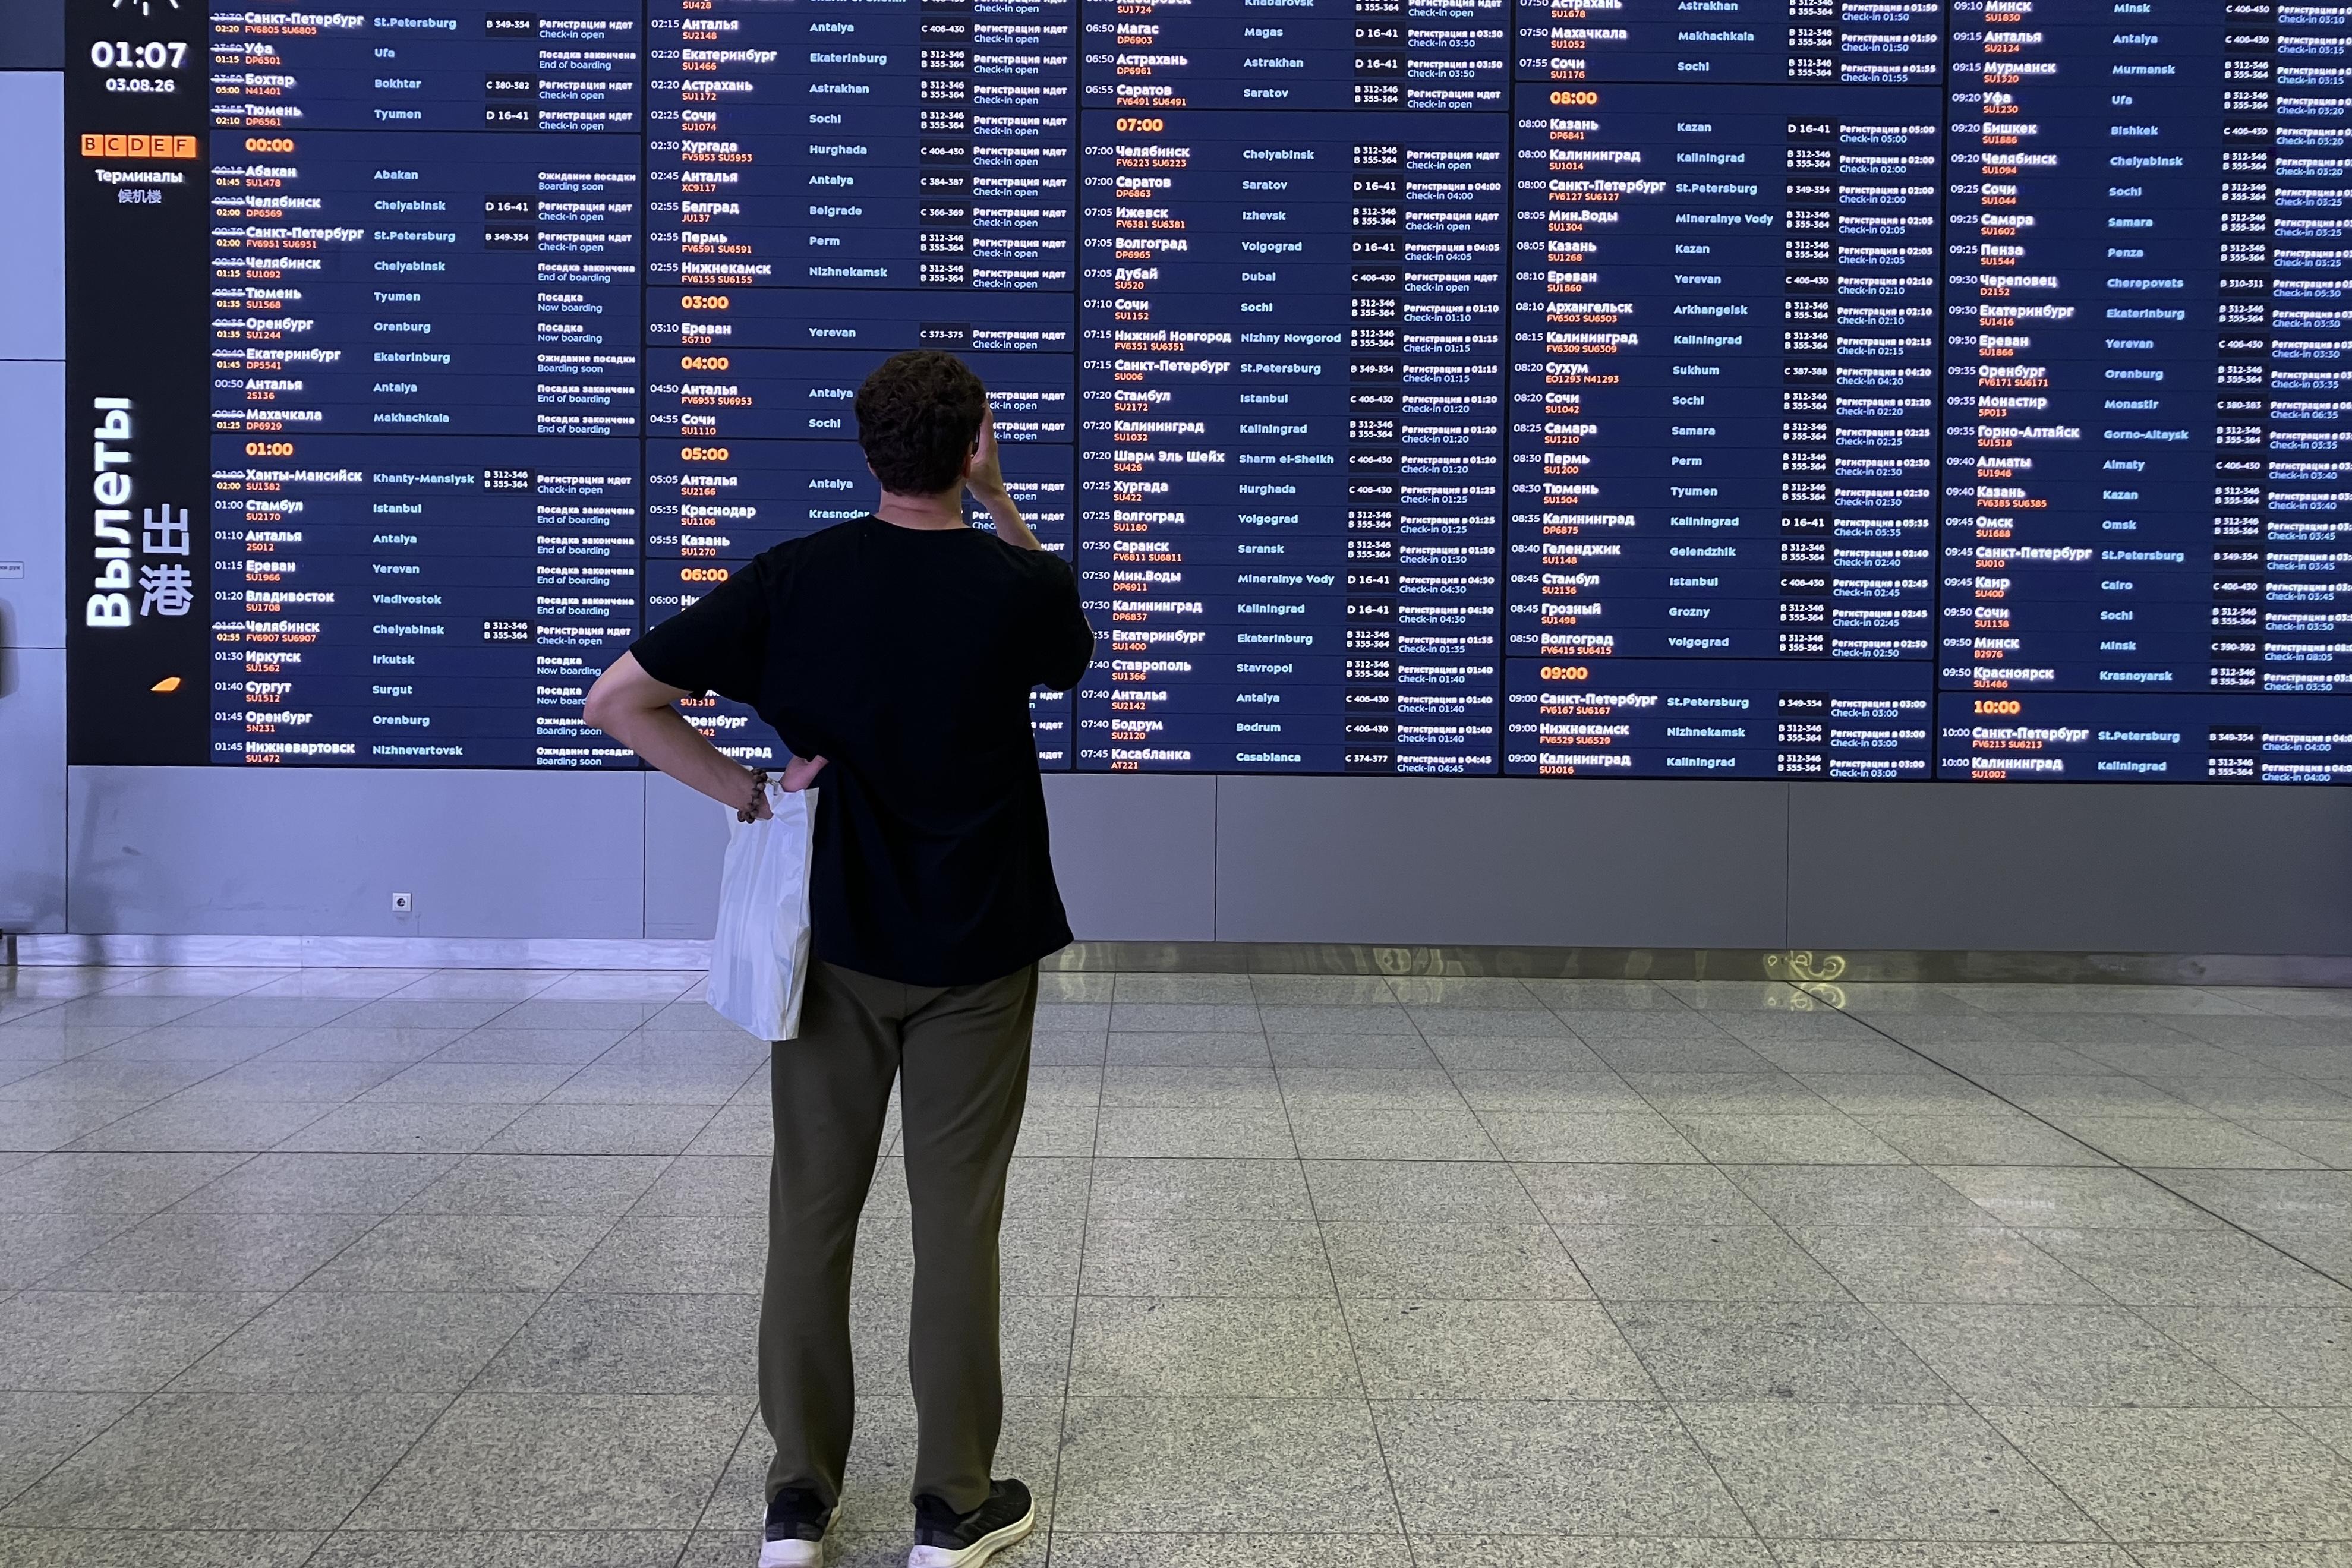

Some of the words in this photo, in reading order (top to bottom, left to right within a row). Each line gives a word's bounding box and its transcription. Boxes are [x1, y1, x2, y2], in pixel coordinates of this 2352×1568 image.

[245, 12, 365, 27] Санкт-Петербург
[374, 18, 456, 30] St.Petersburg
[540, 20, 606, 30] Регистрация
[609, 21, 633, 30] идет
[682, 19, 739, 30] Анталья
[540, 30, 578, 38] Check-in
[1117, 23, 1159, 34] Магас
[1244, 28, 1283, 39] Magas
[91, 41, 187, 68] 01:07
[244, 43, 274, 55] Уфа
[375, 48, 395, 57] Ufa
[540, 51, 581, 59] Посадка
[540, 61, 556, 69] End
[570, 61, 611, 71] boarding
[1984, 62, 2056, 74] Мурманск
[2113, 65, 2175, 74] Murmansk
[106, 78, 175, 92] 03.08.26
[244, 74, 294, 89] Бохтар
[375, 79, 421, 88] Bokhtar
[682, 80, 753, 93] Астрахань
[1550, 92, 1597, 104] 08:00
[374, 109, 421, 121] Tyumen
[487, 111, 494, 119] D
[499, 111, 528, 120] 16-41
[1117, 118, 1163, 131] 07:00
[1678, 123, 1711, 131] Kazan
[1982, 122, 2038, 135] Бишкек
[85, 138, 95, 150] B
[108, 138, 118, 151] C
[131, 139, 143, 151] D
[155, 139, 164, 152] E
[177, 140, 185, 152] F
[246, 138, 294, 152] 00:00
[681, 140, 738, 153] Хургада
[810, 145, 867, 156] Hurghada
[95, 169, 182, 184] Терминалы
[245, 165, 297, 178] Абакан
[374, 170, 418, 179] Abakan
[538, 172, 591, 181] Ожидание
[594, 173, 636, 182] посадки
[539, 182, 579, 192] Boarding
[118, 189, 161, 203] 候机楼
[682, 201, 739, 214] Белград
[810, 206, 862, 217] Belgrade
[1116, 207, 1168, 218] Ижевск
[1243, 211, 1285, 220] Izhevsk
[1116, 238, 1187, 251] Волгоград
[682, 262, 771, 275] Нижнекамск
[1980, 275, 2058, 288] Череповец
[2107, 279, 2183, 289] Cherepovets
[562, 304, 602, 313] boarding
[682, 296, 729, 309] 03:00
[1516, 302, 1544, 311] 08:10
[1546, 302, 1633, 314] Архангельск
[650, 324, 679, 332] 03:10
[682, 323, 732, 336] Ереван
[809, 328, 856, 337] Yerevan
[1115, 330, 1166, 341] Нижний
[1170, 331, 1231, 343] Новгород
[1241, 333, 1280, 344] Nizhny
[1284, 333, 1341, 345] Novgorod
[247, 348, 341, 362] Екатеринбург
[1546, 362, 1588, 375] Сухум
[1673, 365, 1719, 374] Sukhum
[1978, 396, 2047, 409] Монастир
[246, 409, 322, 421] Махачкала
[1544, 423, 1597, 436] Самара
[1978, 425, 2080, 439] Горно-Алтайск
[246, 443, 293, 455] 01:00
[682, 448, 728, 460] 05:00
[1114, 450, 1155, 463] Шарм
[1158, 451, 1183, 462] Эль
[1187, 450, 1225, 462] Шейх
[1240, 454, 1275, 463] Sharm
[1544, 453, 1590, 465] Пермь
[1976, 456, 2032, 469] Алматы
[245, 469, 362, 482] Ханты-Мансийск
[87, 397, 132, 627] Вылеты
[2102, 520, 2136, 529] Omsk
[681, 535, 730, 546] Казань
[1113, 541, 1169, 551] Саранск
[1543, 544, 1621, 556] Геленджик
[139, 504, 194, 616] 出港
[681, 569, 728, 581] 06:00
[1113, 570, 1181, 583] Мин.Воды
[1306, 575, 1335, 585] Vody
[1975, 576, 2010, 589] Каир
[215, 592, 243, 600] 01:20
[246, 590, 335, 603] Владивосток
[1541, 603, 1601, 616] Грозный
[1669, 608, 1710, 618] Grozny
[246, 651, 301, 664] Иркутск
[373, 655, 415, 664] Irkutsk
[1541, 667, 1588, 679] 09:00
[1974, 667, 2054, 680] Красноярск
[2100, 671, 2173, 682] Krasnoyarsk
[1540, 693, 1658, 707] Санкт-Петербург
[1667, 698, 1749, 709] St.Petersburg
[1975, 701, 2020, 714] 10:00
[1237, 723, 1281, 731] Bodrum
[246, 742, 355, 755] Нижневартовск
[373, 746, 462, 755] Nizhnevartovsk
[1112, 749, 1191, 760] Касабланка
[1972, 757, 2063, 771] Калининград
[1972, 770, 2006, 778] SU1002
